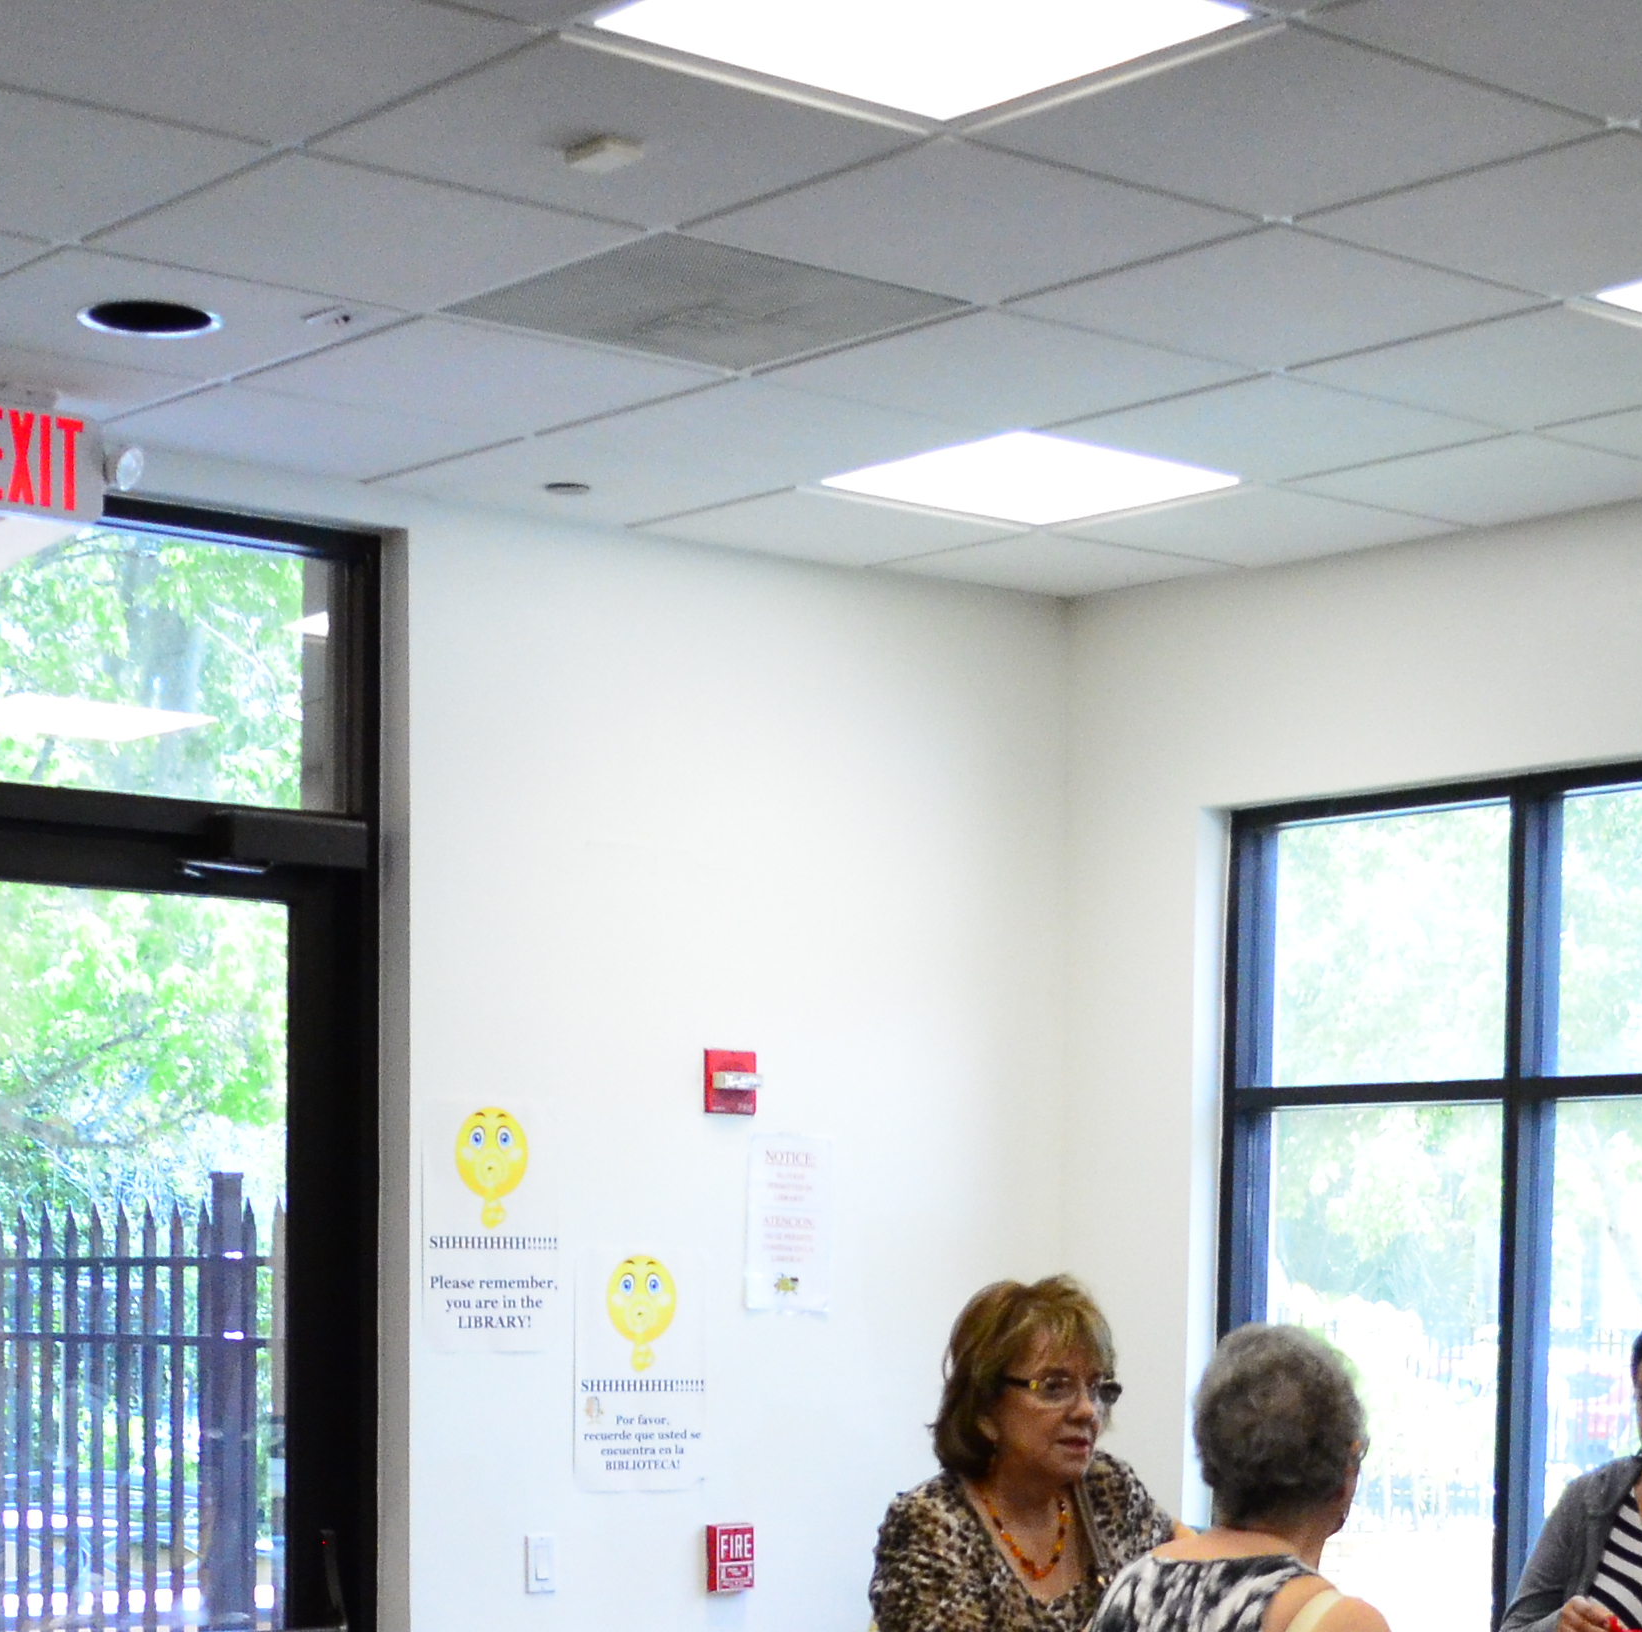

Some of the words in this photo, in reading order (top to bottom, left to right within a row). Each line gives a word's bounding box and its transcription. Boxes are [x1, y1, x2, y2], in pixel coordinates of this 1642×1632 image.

[765, 1150, 816, 1166] NOTICE:
[430, 1275, 475, 1289] Please
[479, 1275, 557, 1290] remember,
[446, 1299, 471, 1312] you
[475, 1299, 498, 1309] are
[502, 1295, 516, 1309] in
[521, 1295, 543, 1309] the
[458, 1315, 531, 1329] LIBRARY!
[616, 1415, 635, 1425] Por
[638, 1414, 669, 1425] favor,
[584, 1430, 632, 1441] recuerde
[634, 1432, 655, 1442] que
[658, 1429, 687, 1439] usted
[600, 1446, 655, 1456] encuentra
[659, 1446, 672, 1455] en
[675, 1444, 684, 1454] la
[605, 1459, 680, 1470] BIBLIOTECA!
[720, 1534, 752, 1560] FIRE
